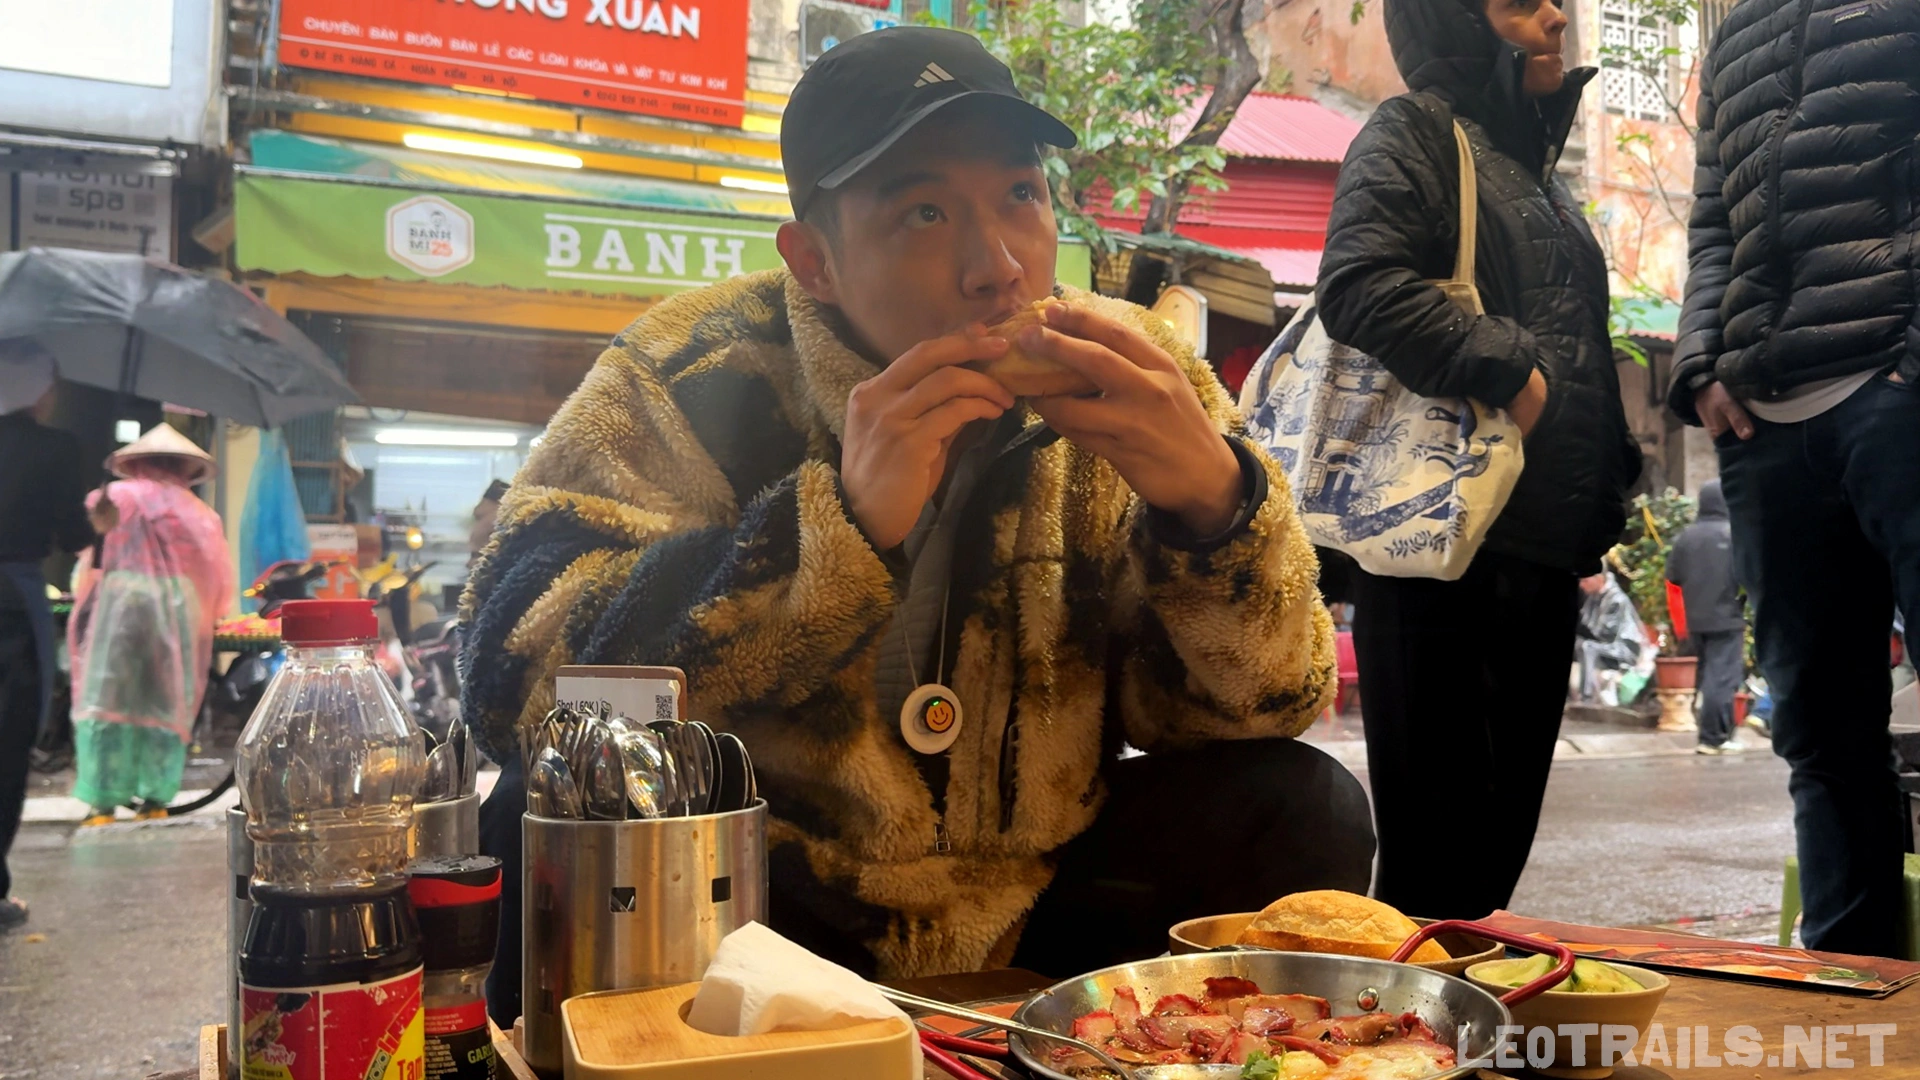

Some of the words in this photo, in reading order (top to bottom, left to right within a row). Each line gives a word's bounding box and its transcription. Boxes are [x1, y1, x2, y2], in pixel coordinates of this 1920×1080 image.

[69, 188, 124, 211] spa
[545, 224, 746, 277] BANH
[468, 1043, 492, 1064] GARL
